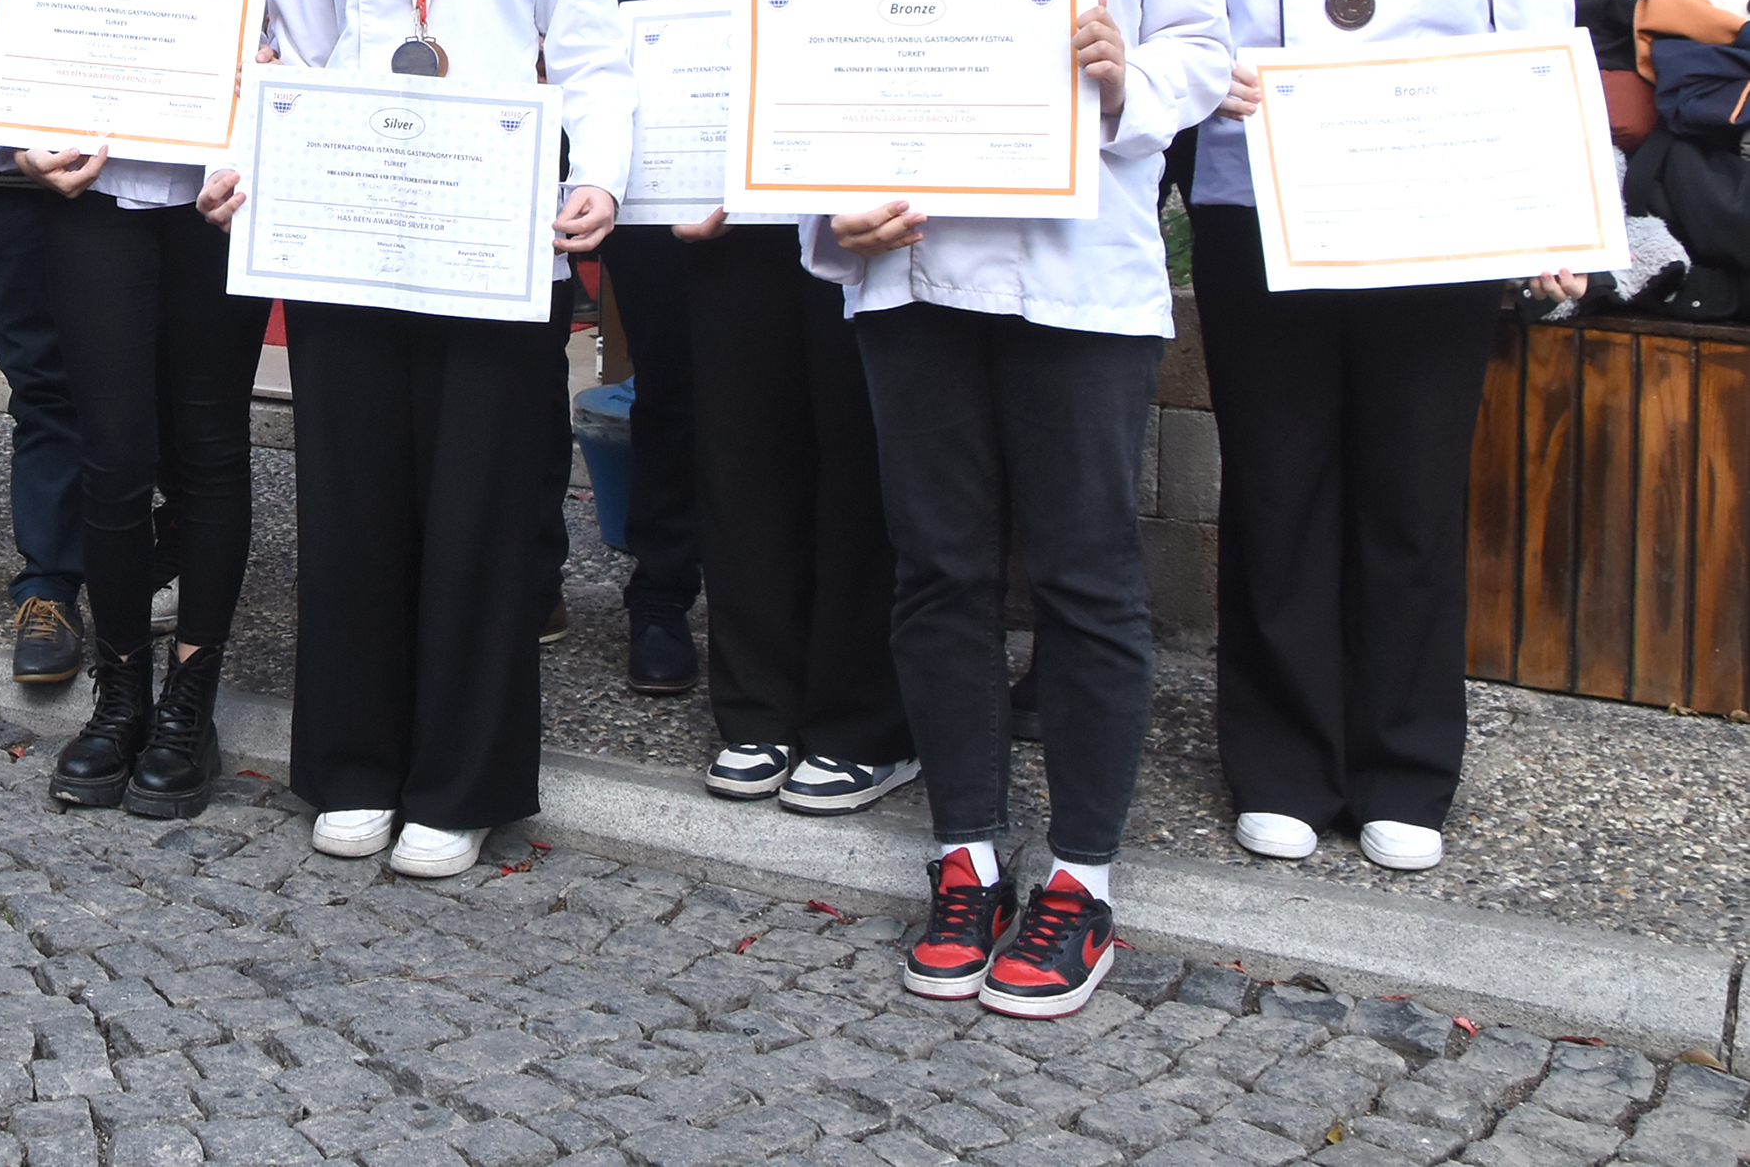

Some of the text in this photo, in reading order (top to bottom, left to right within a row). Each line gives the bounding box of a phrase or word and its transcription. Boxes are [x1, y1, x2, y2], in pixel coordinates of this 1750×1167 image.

[890, 3, 936, 14] Bronze
[1394, 86, 1438, 97] Bronze
[383, 118, 414, 130] Silver
[323, 143, 374, 152] INTERNATIONAL
[376, 146, 405, 156] ISTANBUL
[407, 149, 452, 160] GASTRONOMY
[454, 154, 483, 162] FESTIVAL
[384, 160, 407, 168] TURKEY
[373, 218, 406, 227] AWARDED
[408, 222, 429, 230] SILVER
